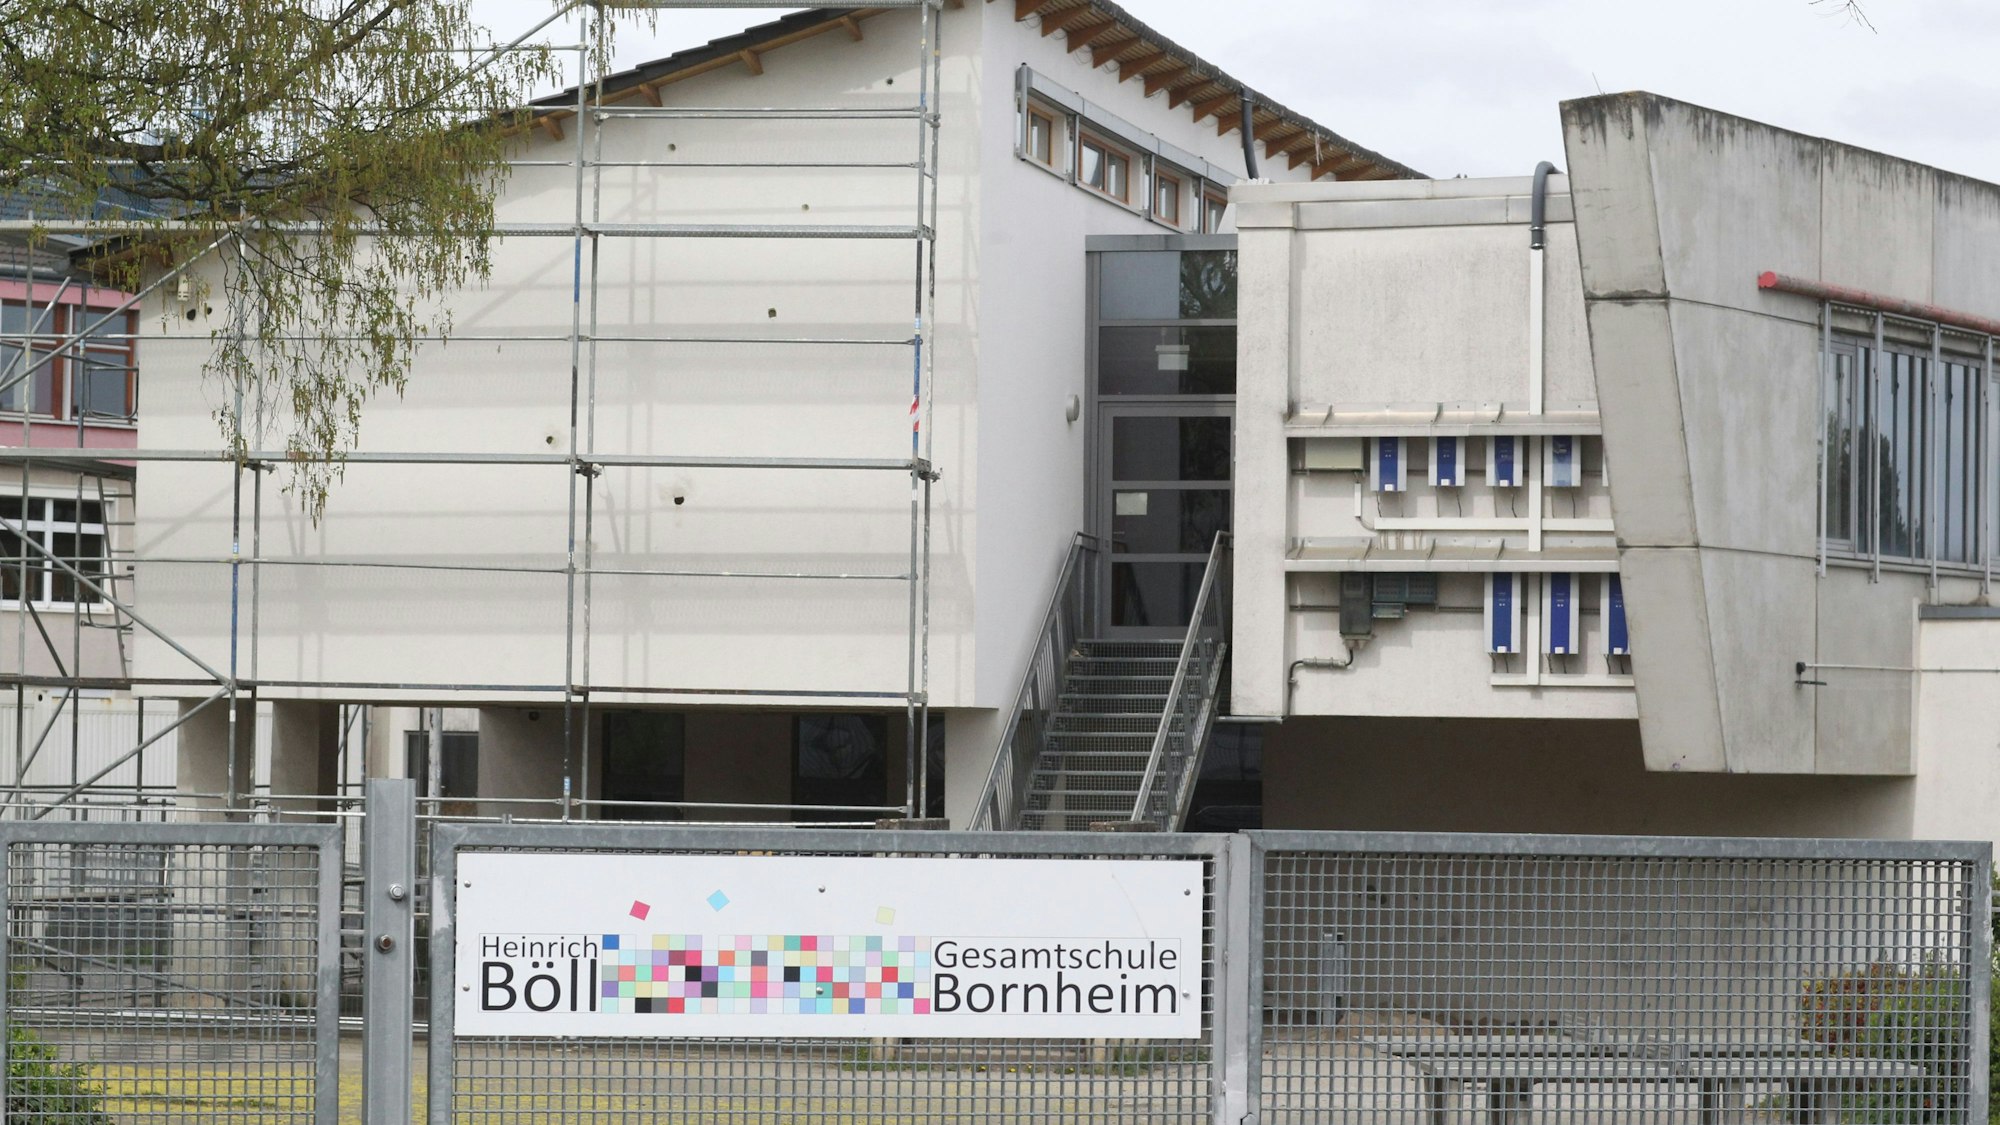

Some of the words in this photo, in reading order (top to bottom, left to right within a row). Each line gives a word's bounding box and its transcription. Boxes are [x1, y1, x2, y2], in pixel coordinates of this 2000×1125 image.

[482, 935, 598, 958] Heinrich
[935, 940, 1177, 970] Gesamtschule
[481, 958, 597, 1012] Böll
[934, 971, 1177, 1014] Bornheim
